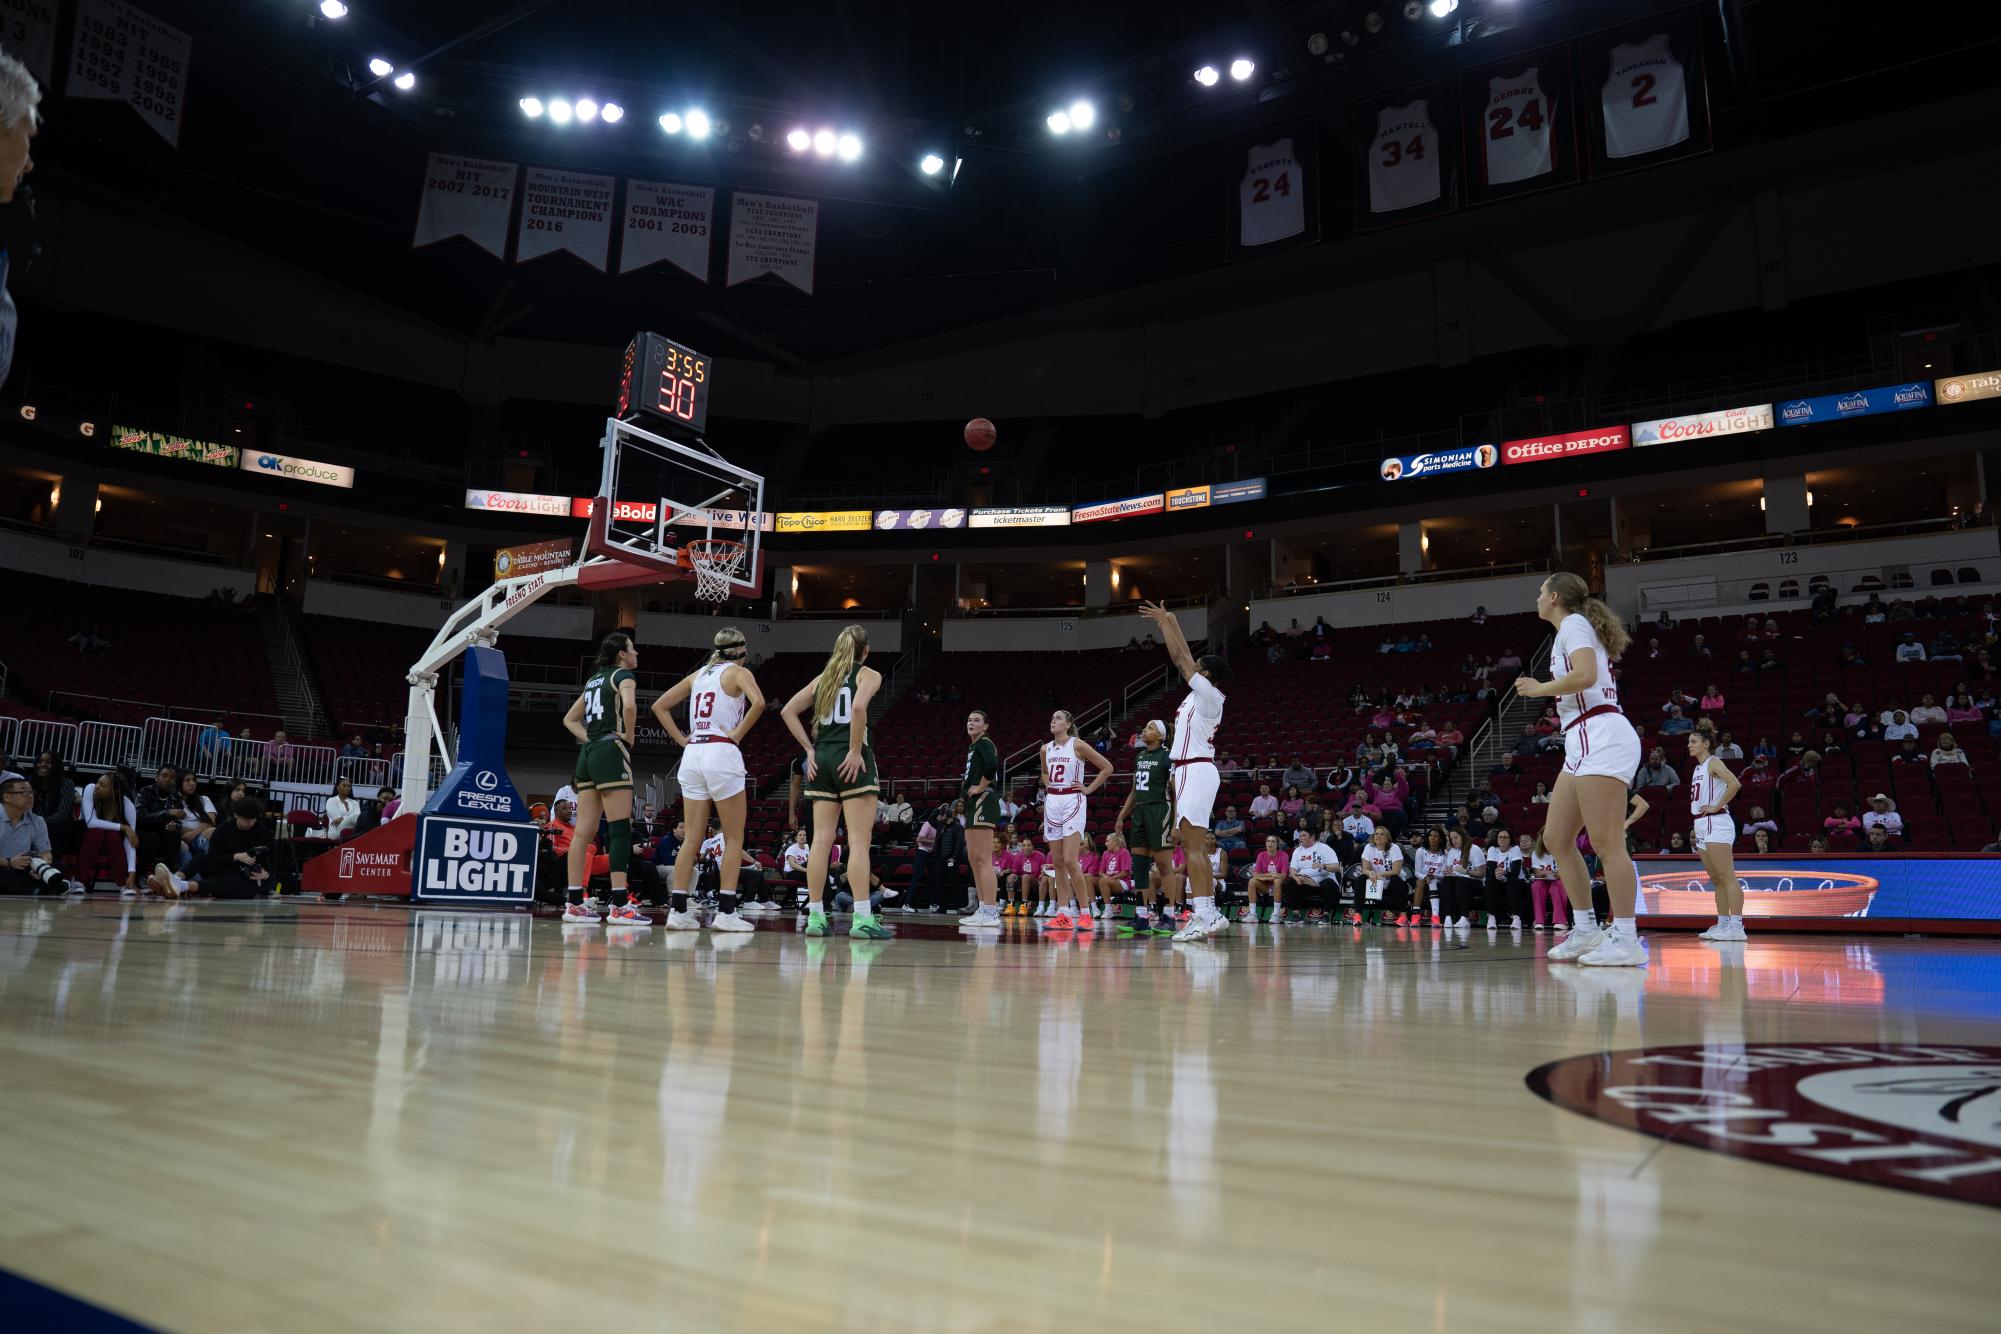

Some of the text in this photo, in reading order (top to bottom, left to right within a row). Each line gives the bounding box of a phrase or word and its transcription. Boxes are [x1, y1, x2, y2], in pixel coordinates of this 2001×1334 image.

[117, 16, 149, 41] NIT
[82, 14, 180, 75] 1983 1985
[136, 59, 178, 90] 1996
[75, 62, 176, 121] 1999 2002
[133, 75, 176, 106] 1998
[1631, 72, 1658, 109] 2
[1489, 98, 1544, 141] 24
[1380, 121, 1427, 139] MARTELL
[1381, 135, 1424, 168] 34
[463, 160, 510, 175] Basketball
[1250, 158, 1293, 175] ROBERTS
[456, 170, 481, 183] NIT
[560, 175, 607, 188] Basketball
[428, 178, 510, 200] 2007 2017
[527, 182, 611, 200] MOUNTAIN WEST
[661, 186, 706, 199] Basketball
[1252, 172, 1291, 204] 24
[527, 193, 610, 212] TOURNAMENT
[656, 196, 685, 208] WAC
[736, 198, 814, 214] Men's Basketball
[531, 205, 604, 222] CHAMPIONS
[632, 204, 706, 222] CHAMPIONS
[527, 218, 564, 233] 2016
[628, 218, 706, 237] 2001 2003
[760, 257, 798, 267] CHAMPIONS
[666, 338, 697, 356] DAKTRONICS
[666, 348, 705, 383] 3:55
[658, 371, 695, 420] 30
[1894, 389, 1928, 403] AQUAFINA
[1782, 405, 1813, 419] AQUAFINA
[1836, 397, 1869, 411] AQUAFINA
[20, 406, 36, 420] G
[80, 422, 95, 437] G
[1659, 413, 1770, 440] Coors LIGHT
[1507, 435, 1621, 460] Office DEPOT
[1424, 453, 1472, 465] SIMONIAN
[1442, 460, 1472, 469] Medicine
[284, 462, 338, 482] produce
[486, 493, 569, 513] Coors LIGHT
[1171, 494, 1206, 506] TOUCHSTONE
[587, 504, 656, 520] #eBold
[1074, 498, 1161, 520] FresnoStateNews.com
[777, 515, 801, 528] Topo
[801, 514, 825, 529] Chico
[993, 515, 1046, 524] ticketmaster
[69, 547, 85, 561] 102
[513, 550, 571, 565] TABLE MOUNTAIN
[1780, 551, 1798, 564] 123
[517, 558, 565, 570] CASINO RESORT
[505, 575, 545, 609] FRESNO STATE
[1376, 591, 1391, 604] 124
[440, 600, 453, 611] 101
[758, 623, 770, 634] 126
[1060, 620, 1073, 632] 125
[584, 688, 604, 724] 24
[694, 691, 716, 720] 13
[1048, 764, 1065, 783] 12
[1135, 770, 1150, 791] 32
[458, 790, 511, 805] FRESNO
[458, 799, 511, 813] LEXUS
[444, 827, 518, 861] BUD
[1373, 857, 1384, 866] 24
[1540, 864, 1552, 872] 24
[360, 867, 391, 877] CENTER
[426, 858, 530, 893] LIGHT
